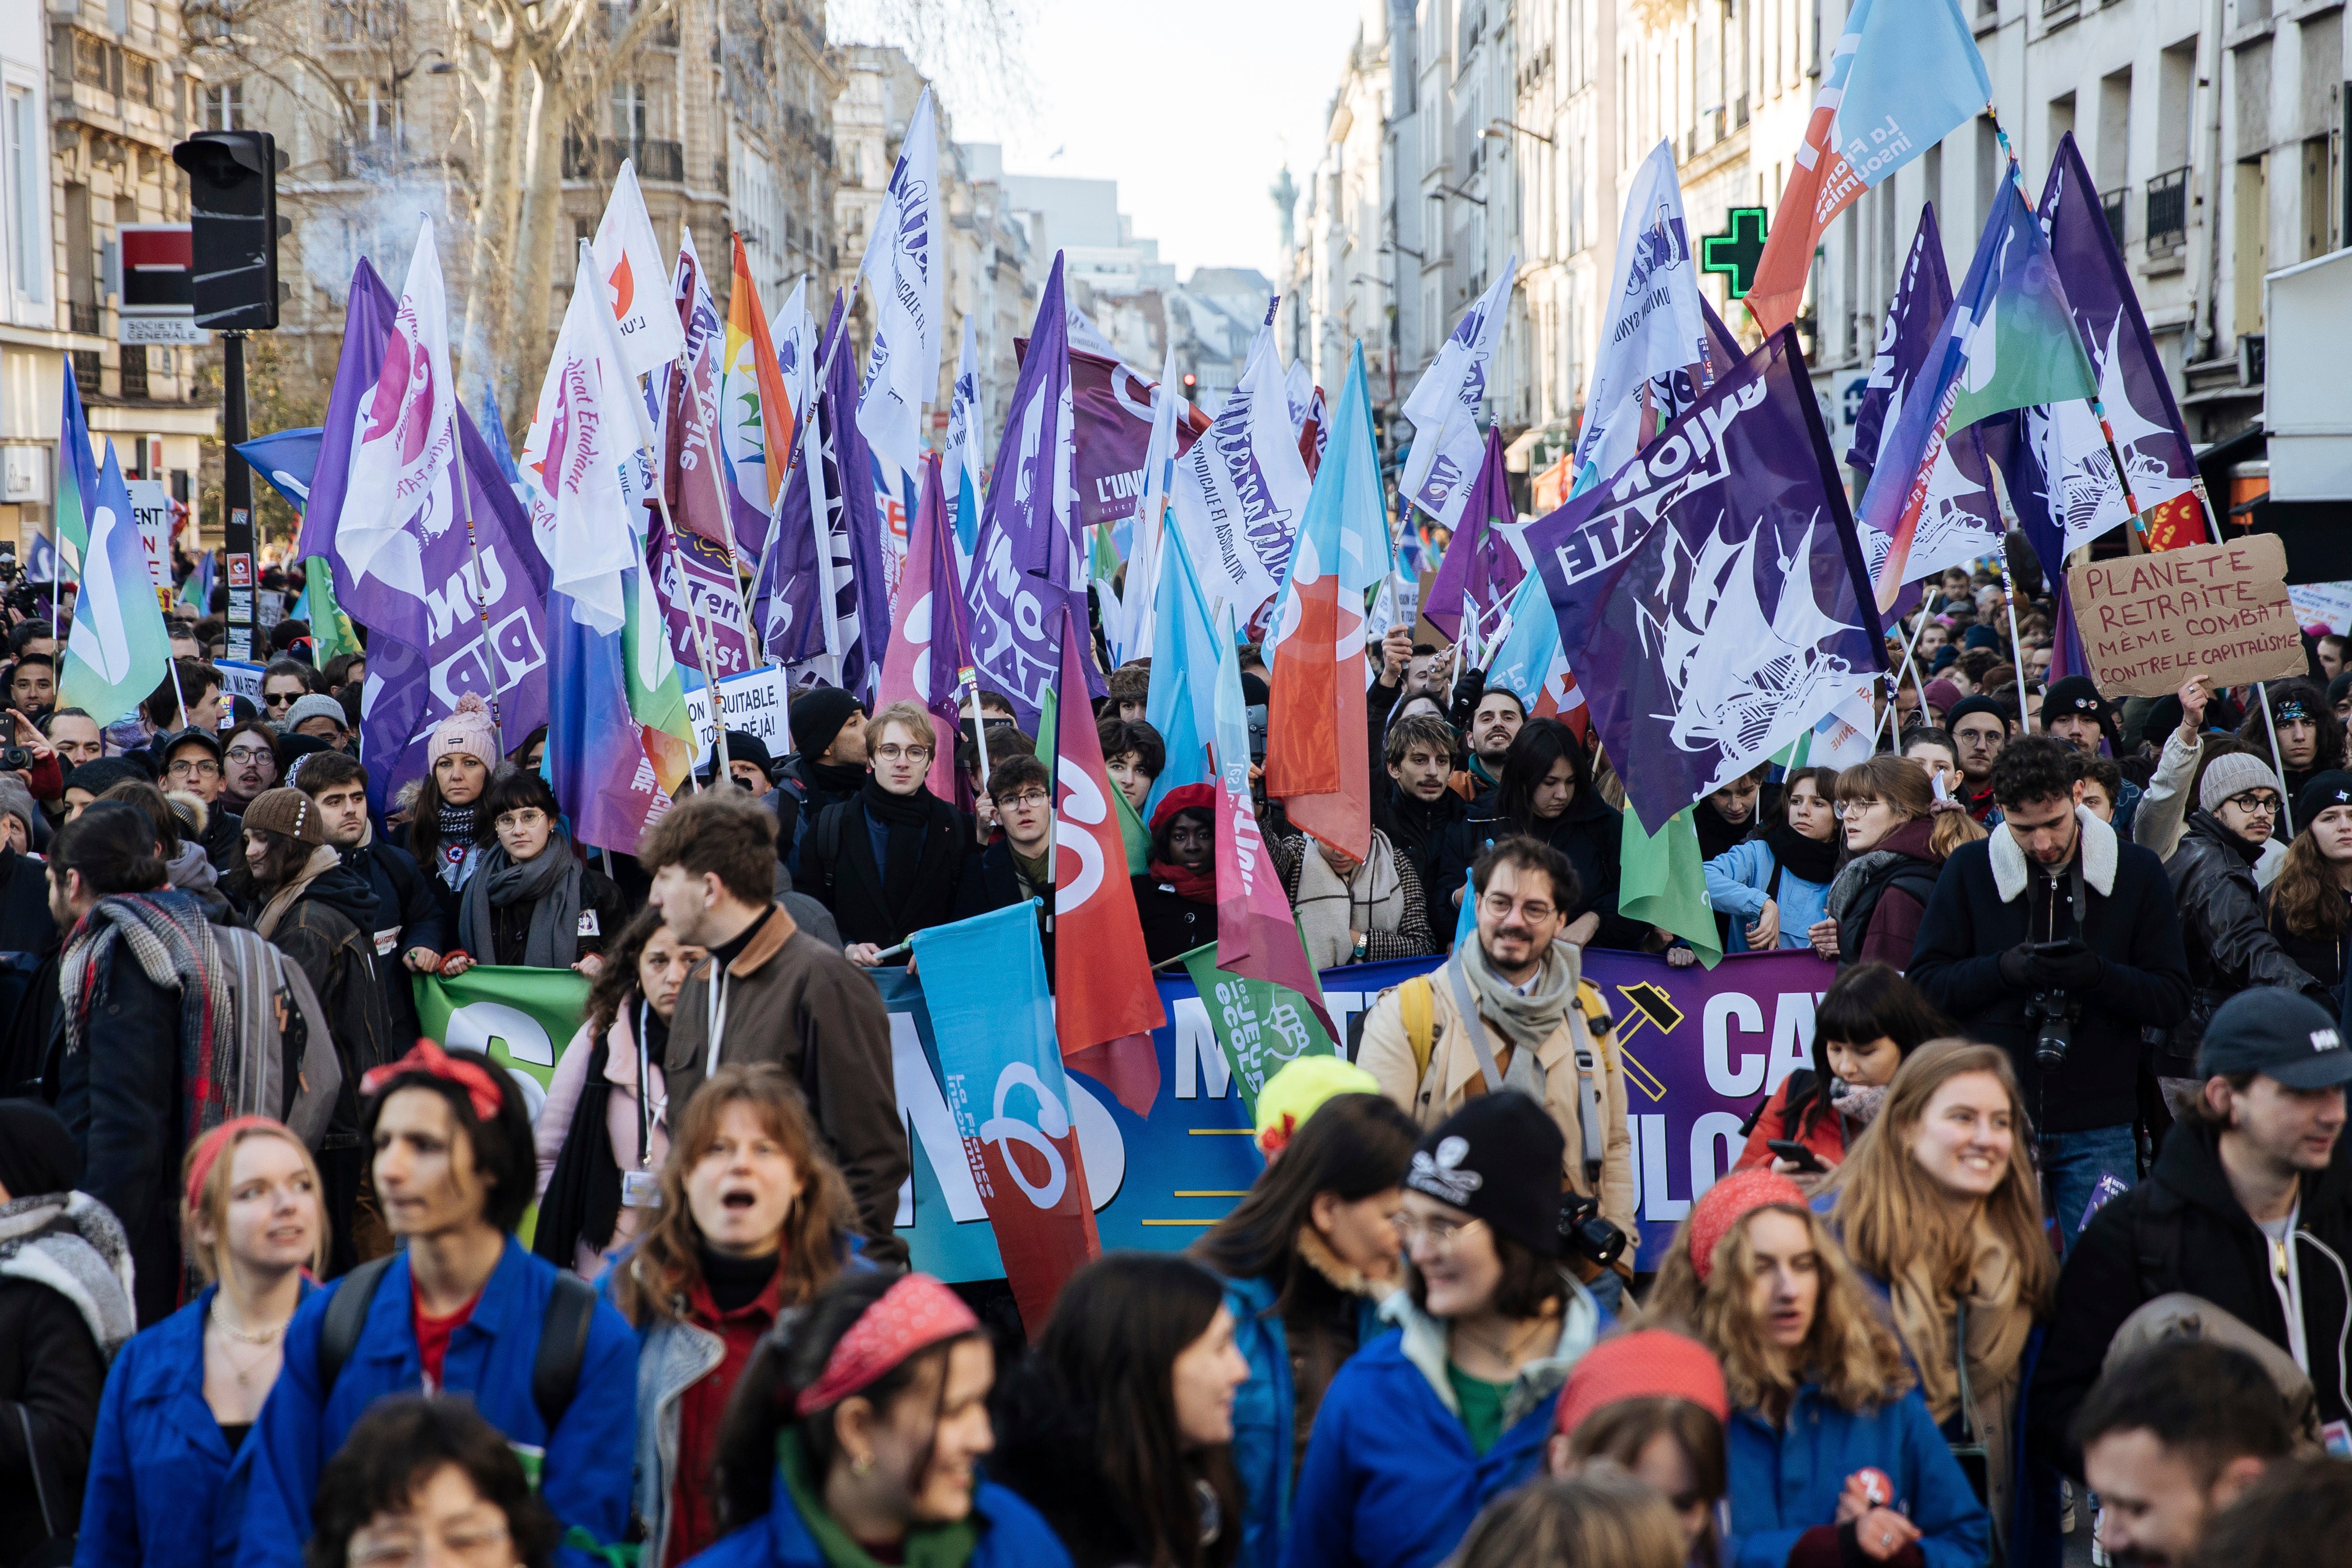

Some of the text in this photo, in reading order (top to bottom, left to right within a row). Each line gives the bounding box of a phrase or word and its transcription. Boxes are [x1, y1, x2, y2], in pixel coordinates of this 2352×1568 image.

[1102, 503, 1135, 514] ÉLECT
[1192, 439, 1248, 585] SYNDICALE ET ASSOCIATIVE
[2086, 550, 2254, 600] PLANETE
[2098, 628, 2176, 658] MÊME
[2185, 598, 2290, 636] COMBAT
[718, 685, 780, 714] QUITABLE,
[1506, 662, 1527, 691] La
[1703, 992, 1824, 1098] CA
[947, 1074, 987, 1198] insoumise
[956, 1073, 995, 1198] La France
